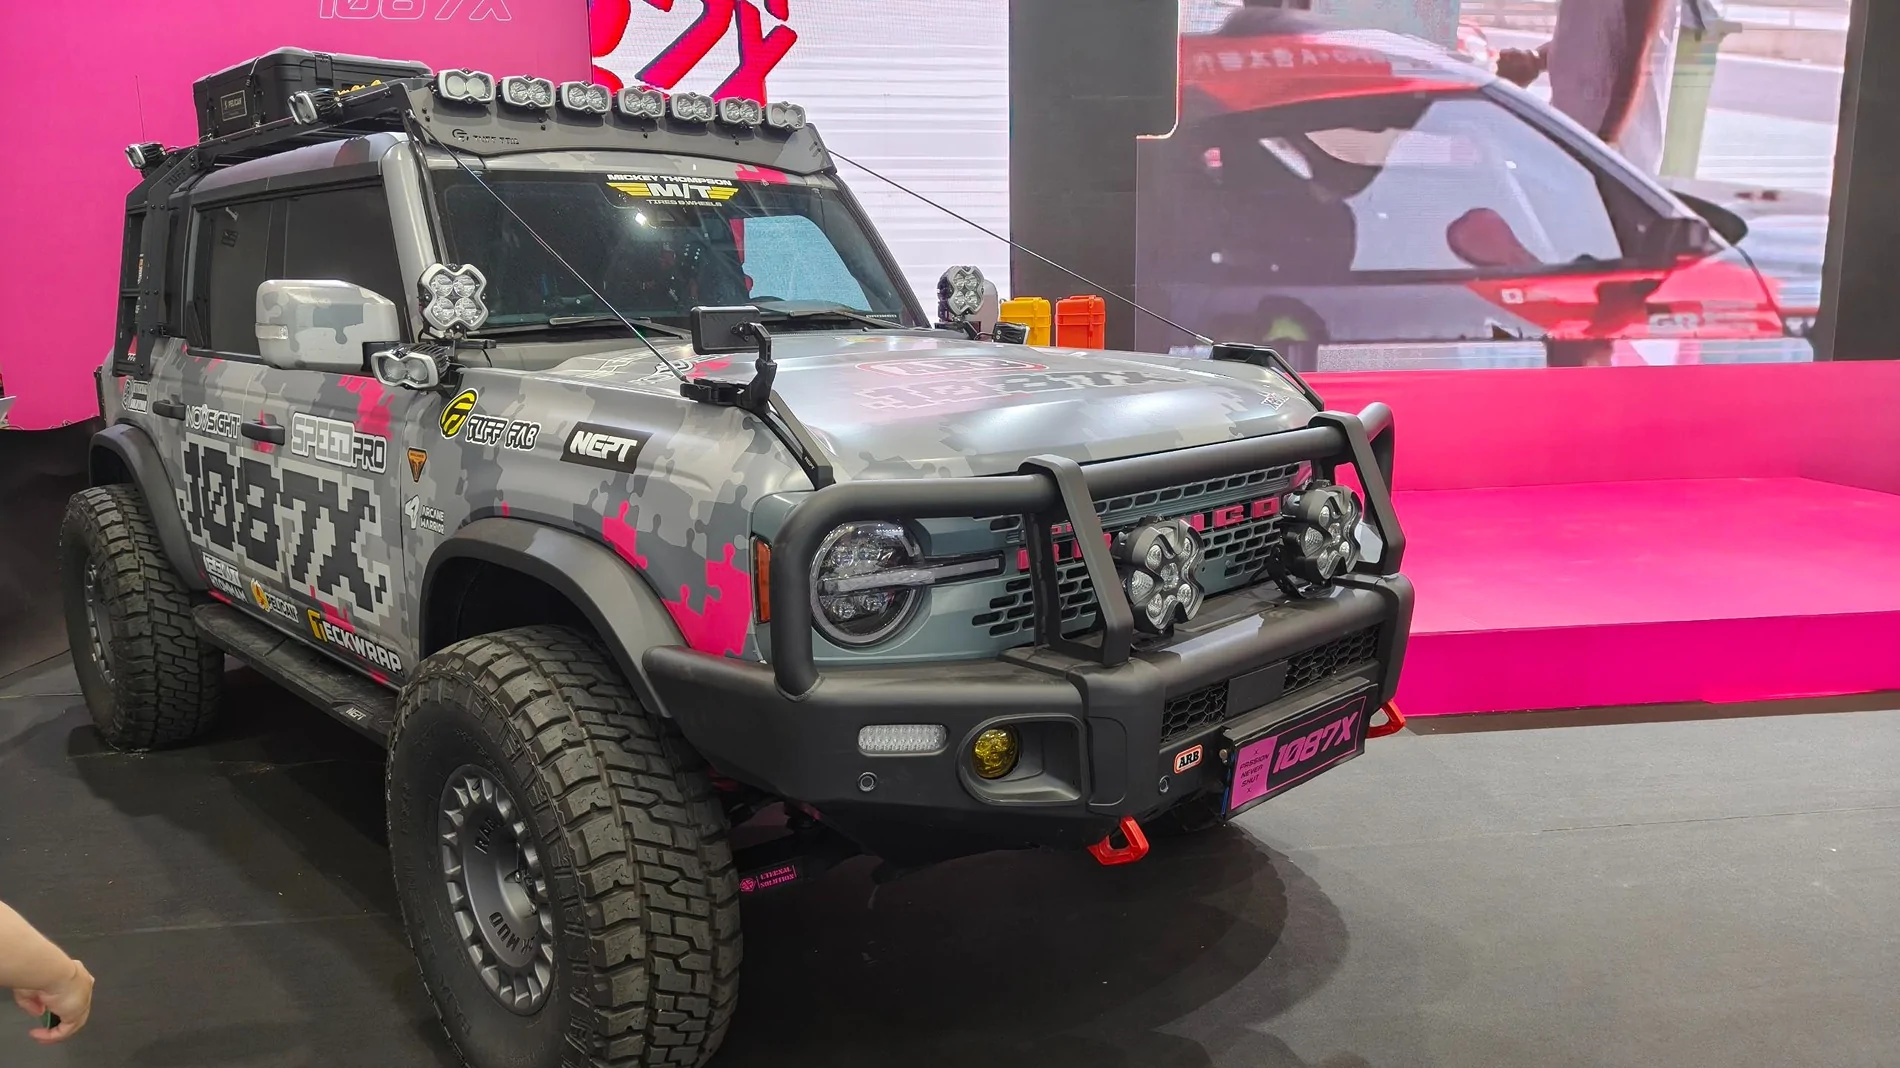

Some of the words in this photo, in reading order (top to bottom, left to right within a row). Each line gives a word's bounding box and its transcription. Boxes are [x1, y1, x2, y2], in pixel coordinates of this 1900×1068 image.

[606, 174, 658, 183] MICKEY
[661, 175, 733, 187] THOMPSON
[646, 183, 712, 199] M/T
[466, 415, 508, 445] TUFF
[504, 421, 541, 451] FAB
[569, 430, 639, 463] NEPT
[421, 505, 445, 522] ARCANE
[182, 440, 387, 615] 1087X
[1273, 711, 1358, 774] 1087X
[1178, 751, 1200, 768] ARB
